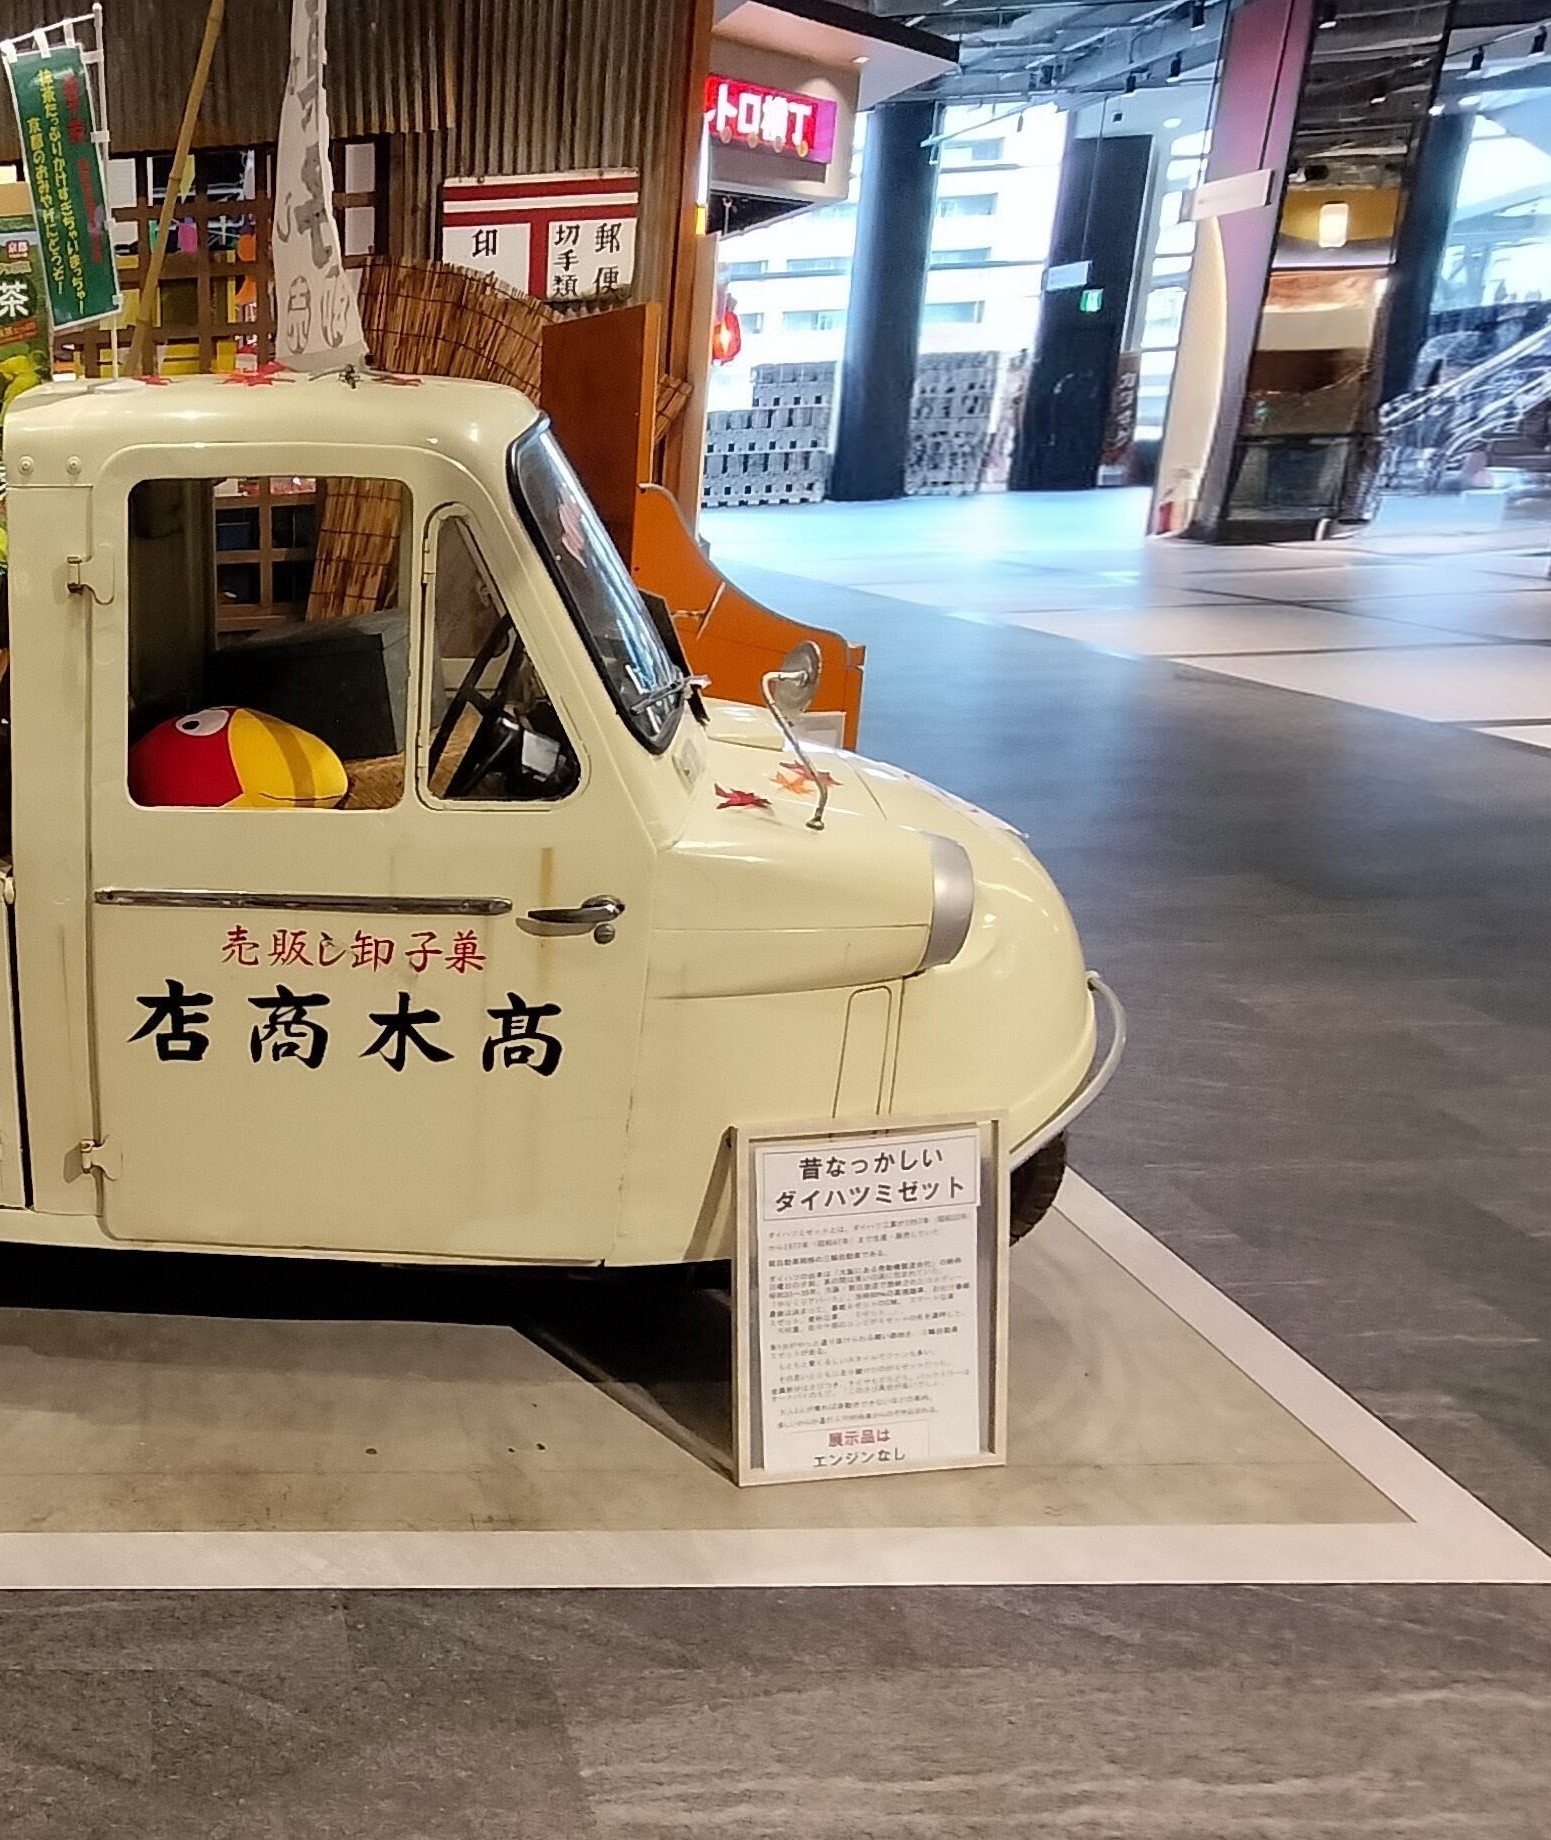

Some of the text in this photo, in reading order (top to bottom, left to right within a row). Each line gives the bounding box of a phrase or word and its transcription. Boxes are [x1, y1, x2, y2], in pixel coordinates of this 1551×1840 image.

[553, 224, 582, 298] 切手類
[593, 222, 623, 296] 郵便
[799, 1148, 944, 1181] 昔なつかしい
[775, 1175, 965, 1213] ダイハツミゼット
[828, 1428, 891, 1449] 展示品は
[813, 1446, 907, 1469] エンジンなし
